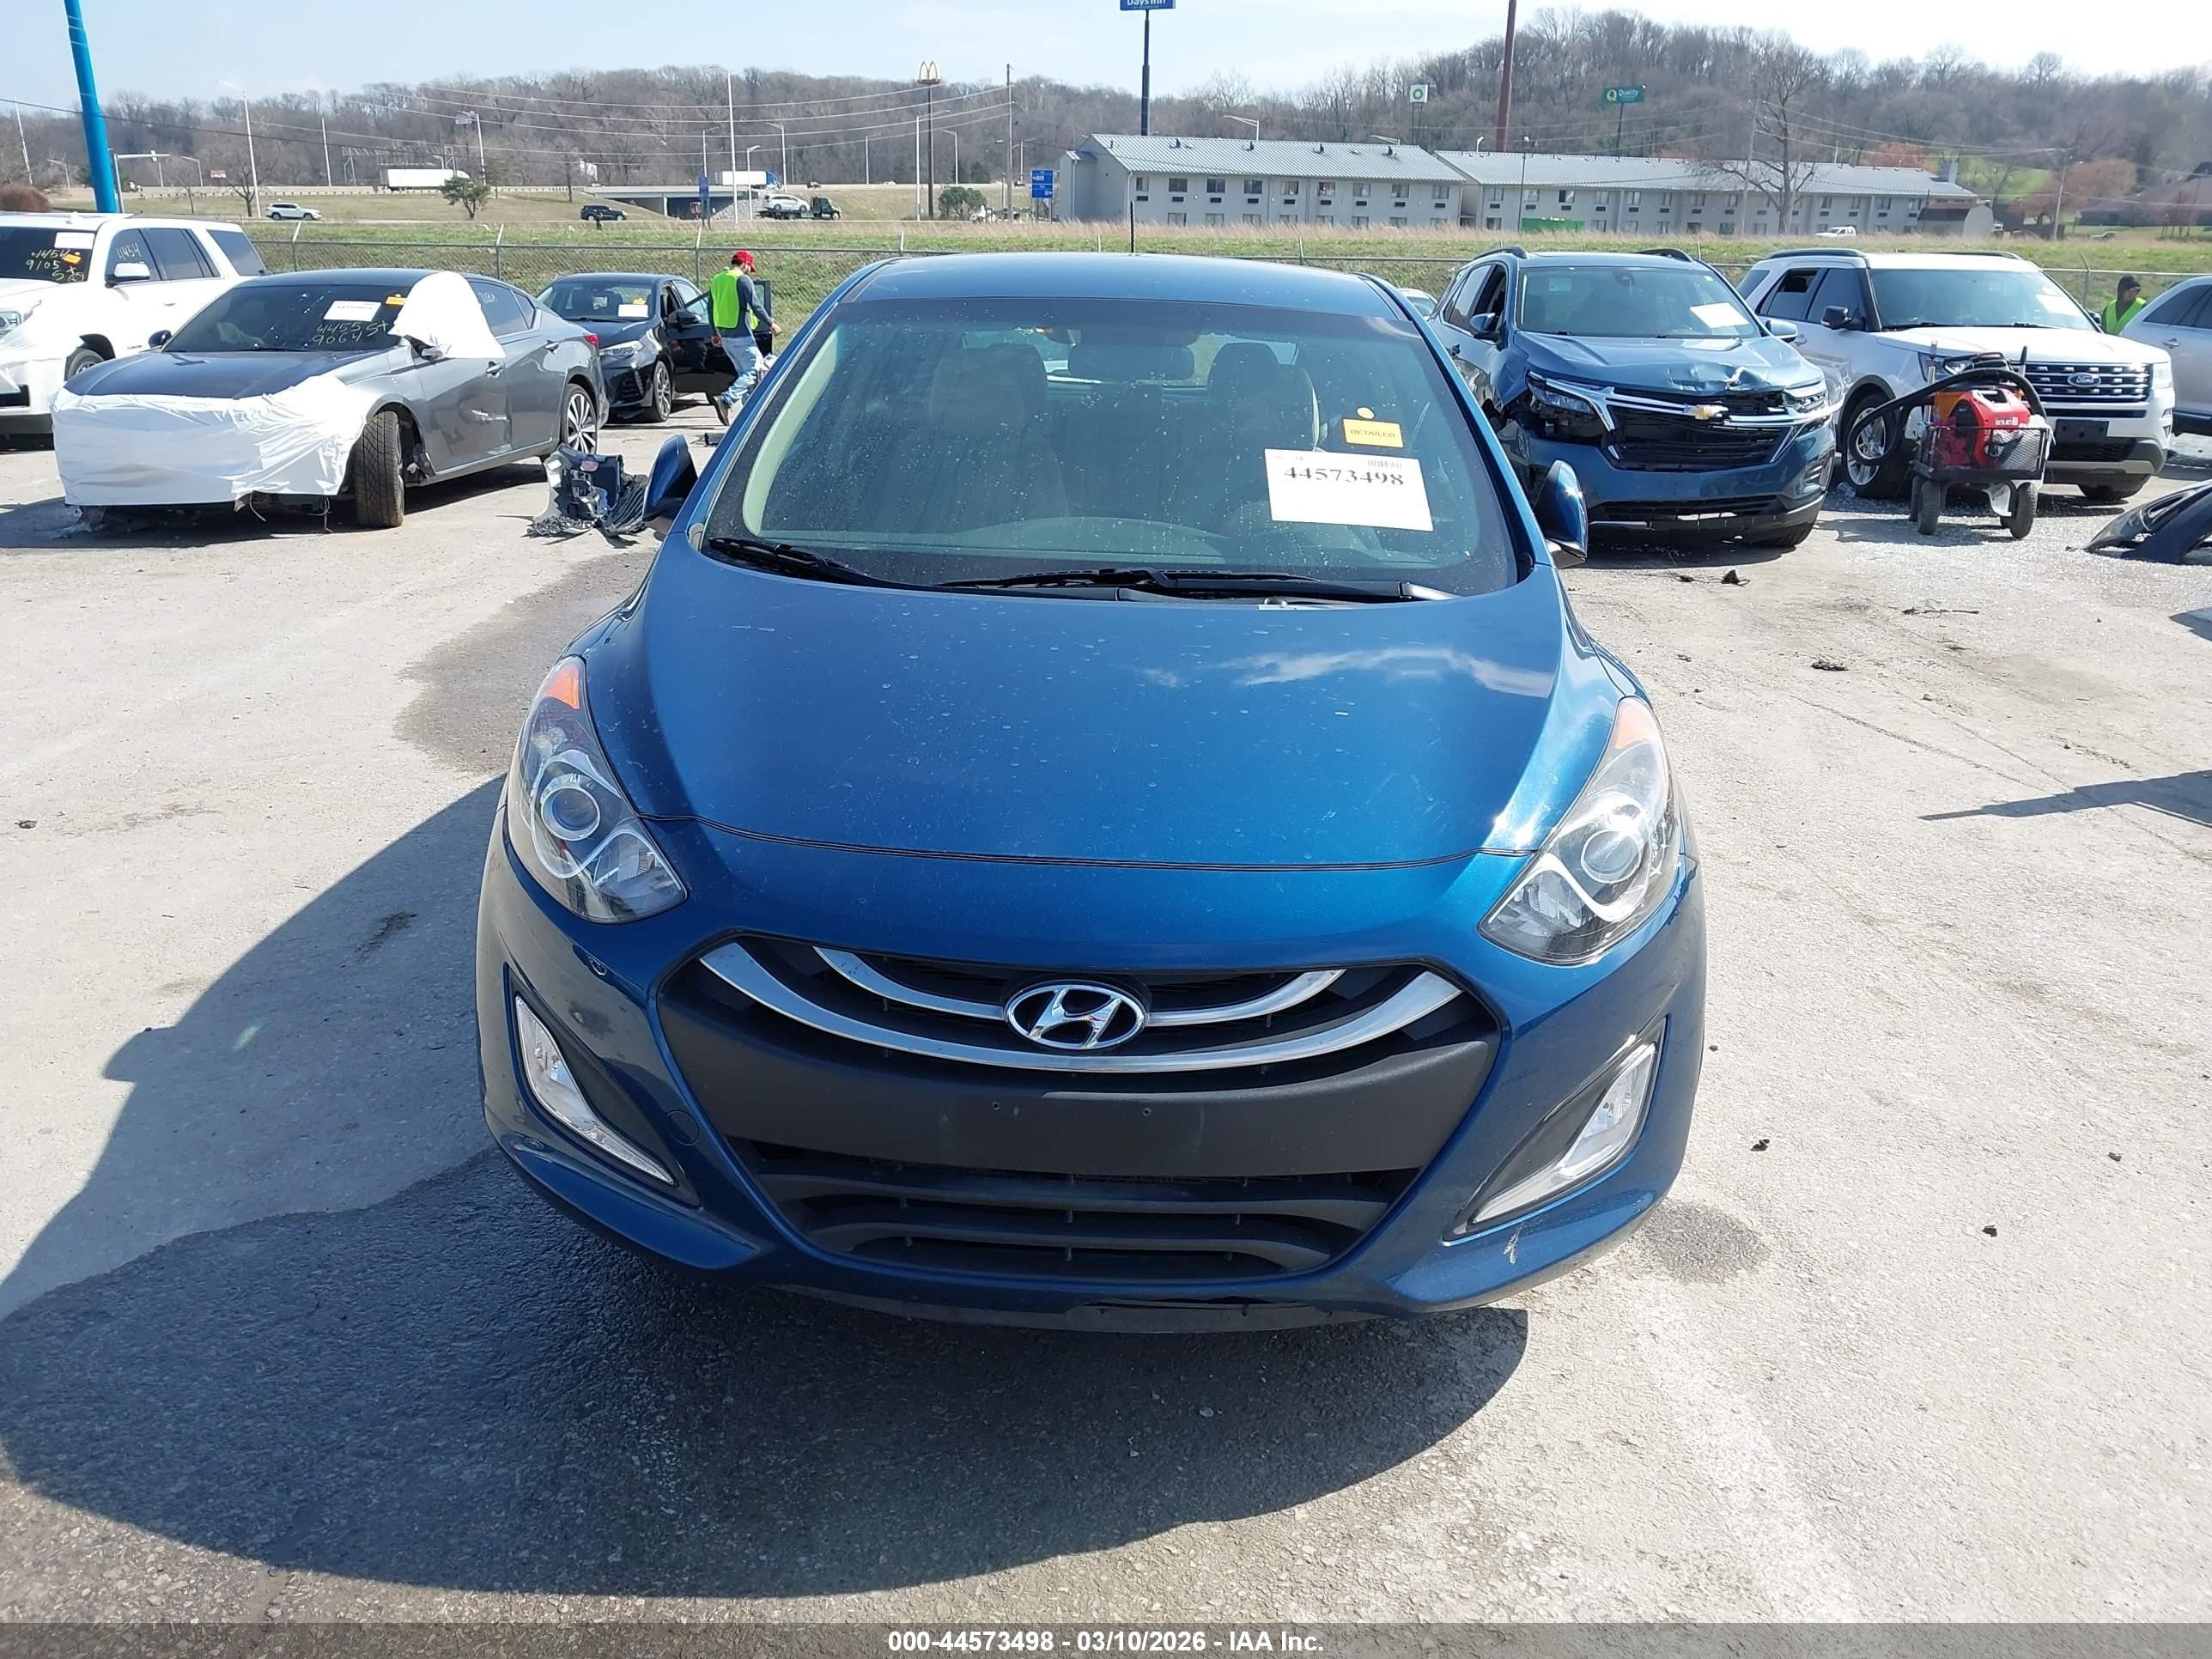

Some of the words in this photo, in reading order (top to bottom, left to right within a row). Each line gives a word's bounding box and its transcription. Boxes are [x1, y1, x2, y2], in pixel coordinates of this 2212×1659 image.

[26, 259, 61, 270] 9105
[317, 322, 362, 333] 4455
[312, 331, 362, 345] 9064
[2076, 374, 2094, 383] Ford
[1350, 428, 1395, 438] DETAILED
[1285, 466, 1404, 486] 44573498
